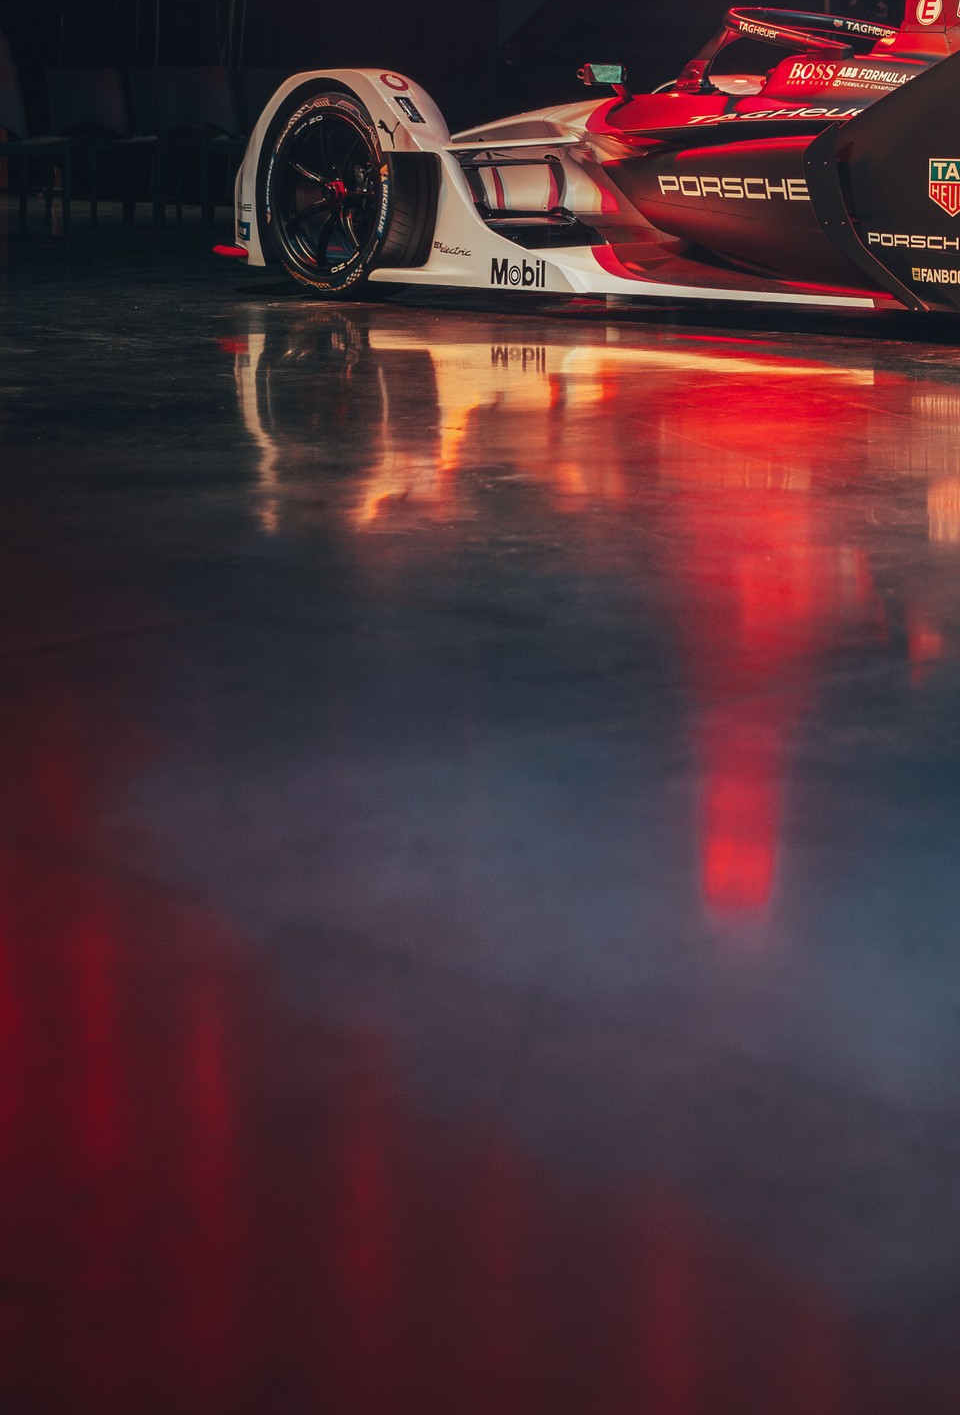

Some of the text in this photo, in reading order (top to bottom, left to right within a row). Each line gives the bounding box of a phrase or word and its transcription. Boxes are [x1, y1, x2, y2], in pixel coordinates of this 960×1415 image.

[739, 21, 779, 39] TAGHeuer
[788, 62, 836, 80] BOSS
[837, 67, 859, 78] ABB
[657, 175, 811, 201] PORSCHE
[378, 184, 388, 233] MICHELIN
[490, 257, 546, 288] Mobil
